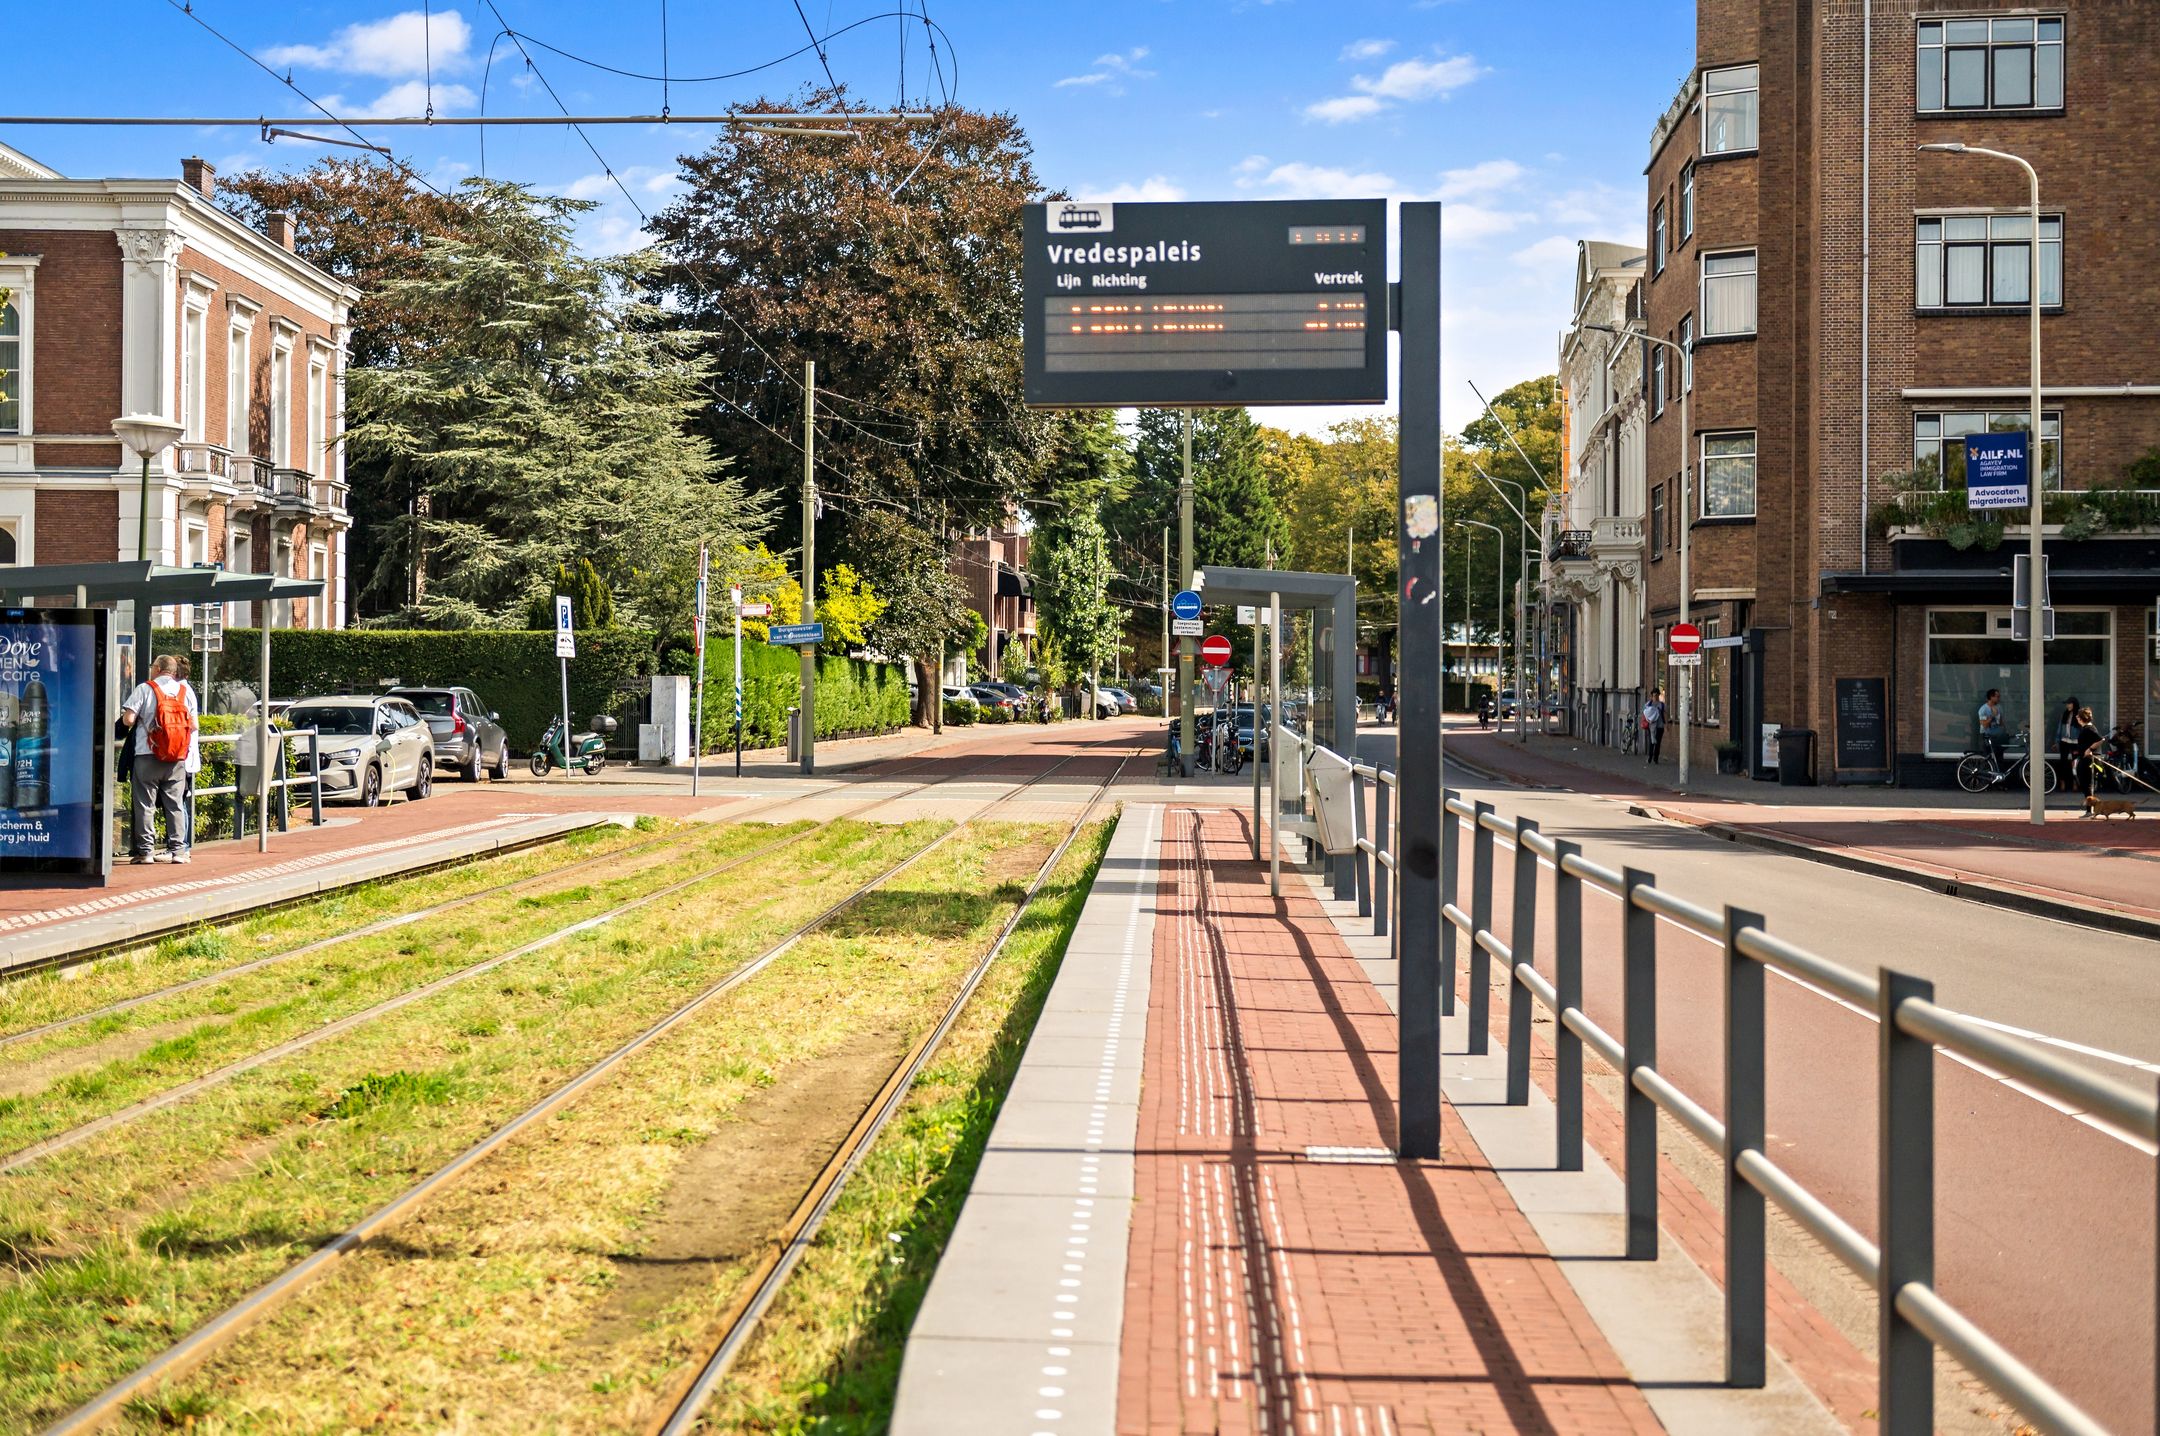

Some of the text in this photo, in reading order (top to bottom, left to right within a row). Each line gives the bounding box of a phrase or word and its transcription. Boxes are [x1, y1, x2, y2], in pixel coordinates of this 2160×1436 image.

[1047, 240, 1201, 268] Vredespaleis
[1056, 273, 1148, 290] Lijn Richting
[1314, 270, 1364, 285] Vertrek
[1980, 449, 2023, 460] AILF.NL
[1975, 488, 2020, 497] Advocaten
[1969, 496, 2026, 507] migratierecht
[35, 821, 43, 830] &
[15, 832, 26, 844] je
[28, 832, 50, 842] huid
